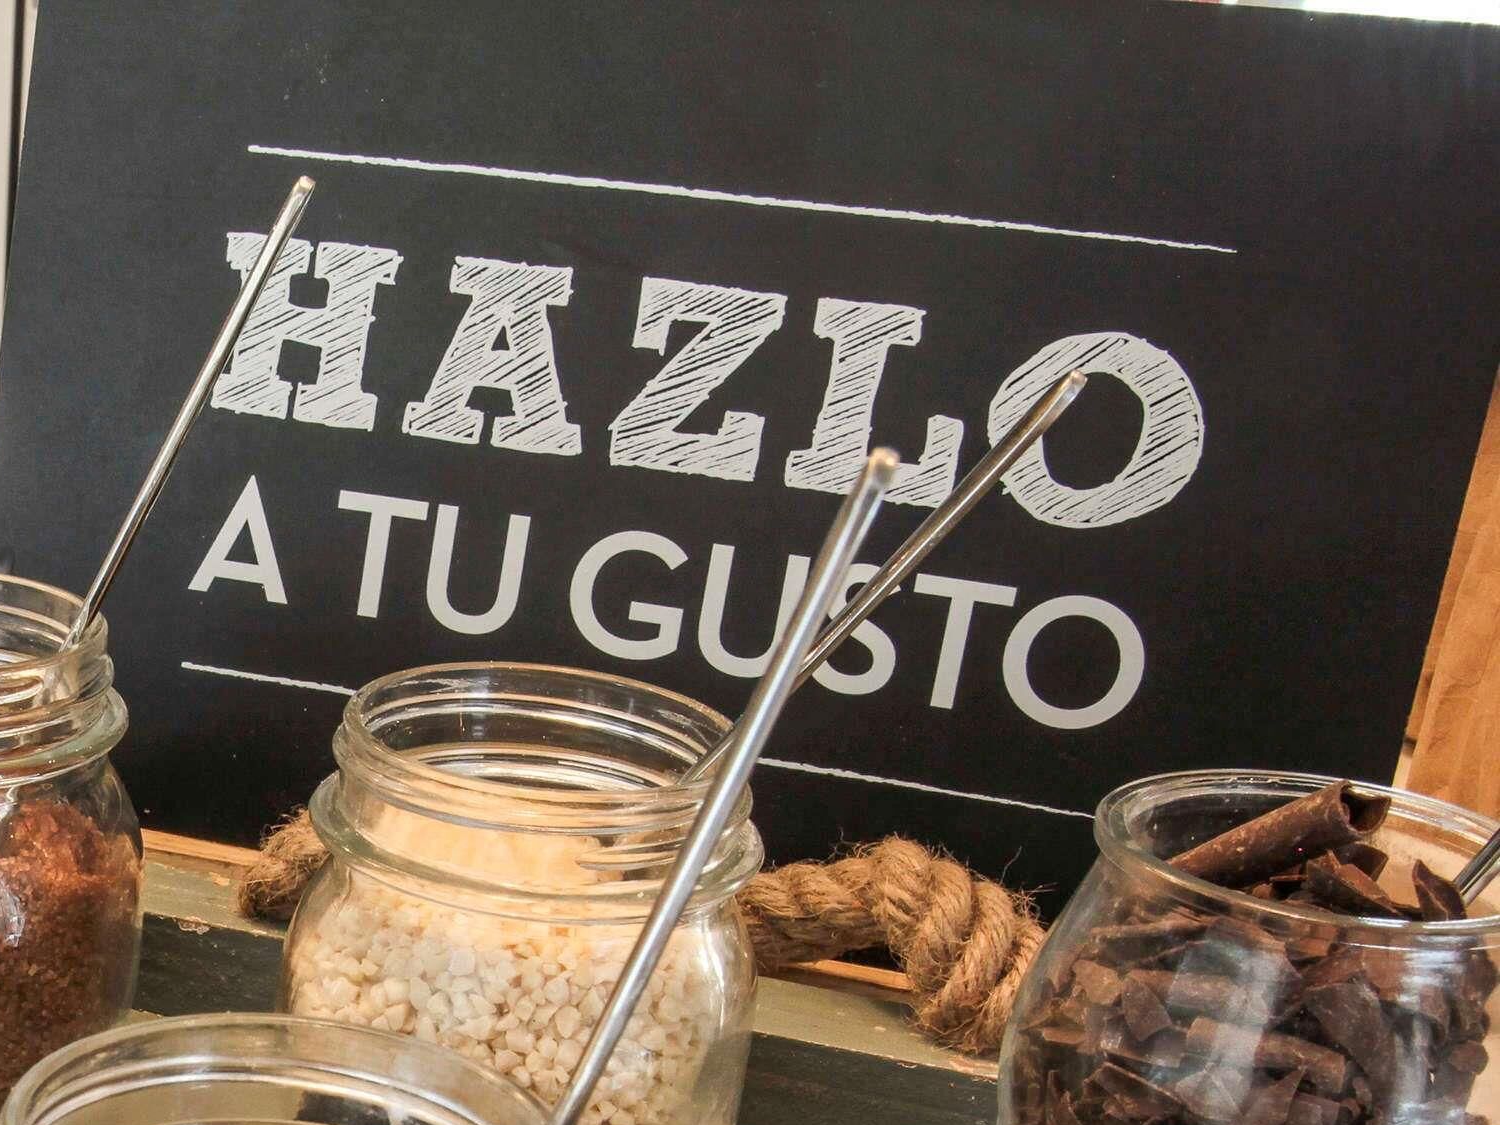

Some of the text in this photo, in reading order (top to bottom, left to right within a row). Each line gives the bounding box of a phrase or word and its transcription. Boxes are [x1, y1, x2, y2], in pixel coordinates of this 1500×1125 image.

[209, 231, 1205, 530] HAZLO
[187, 474, 1145, 730] A TU GUSTO
